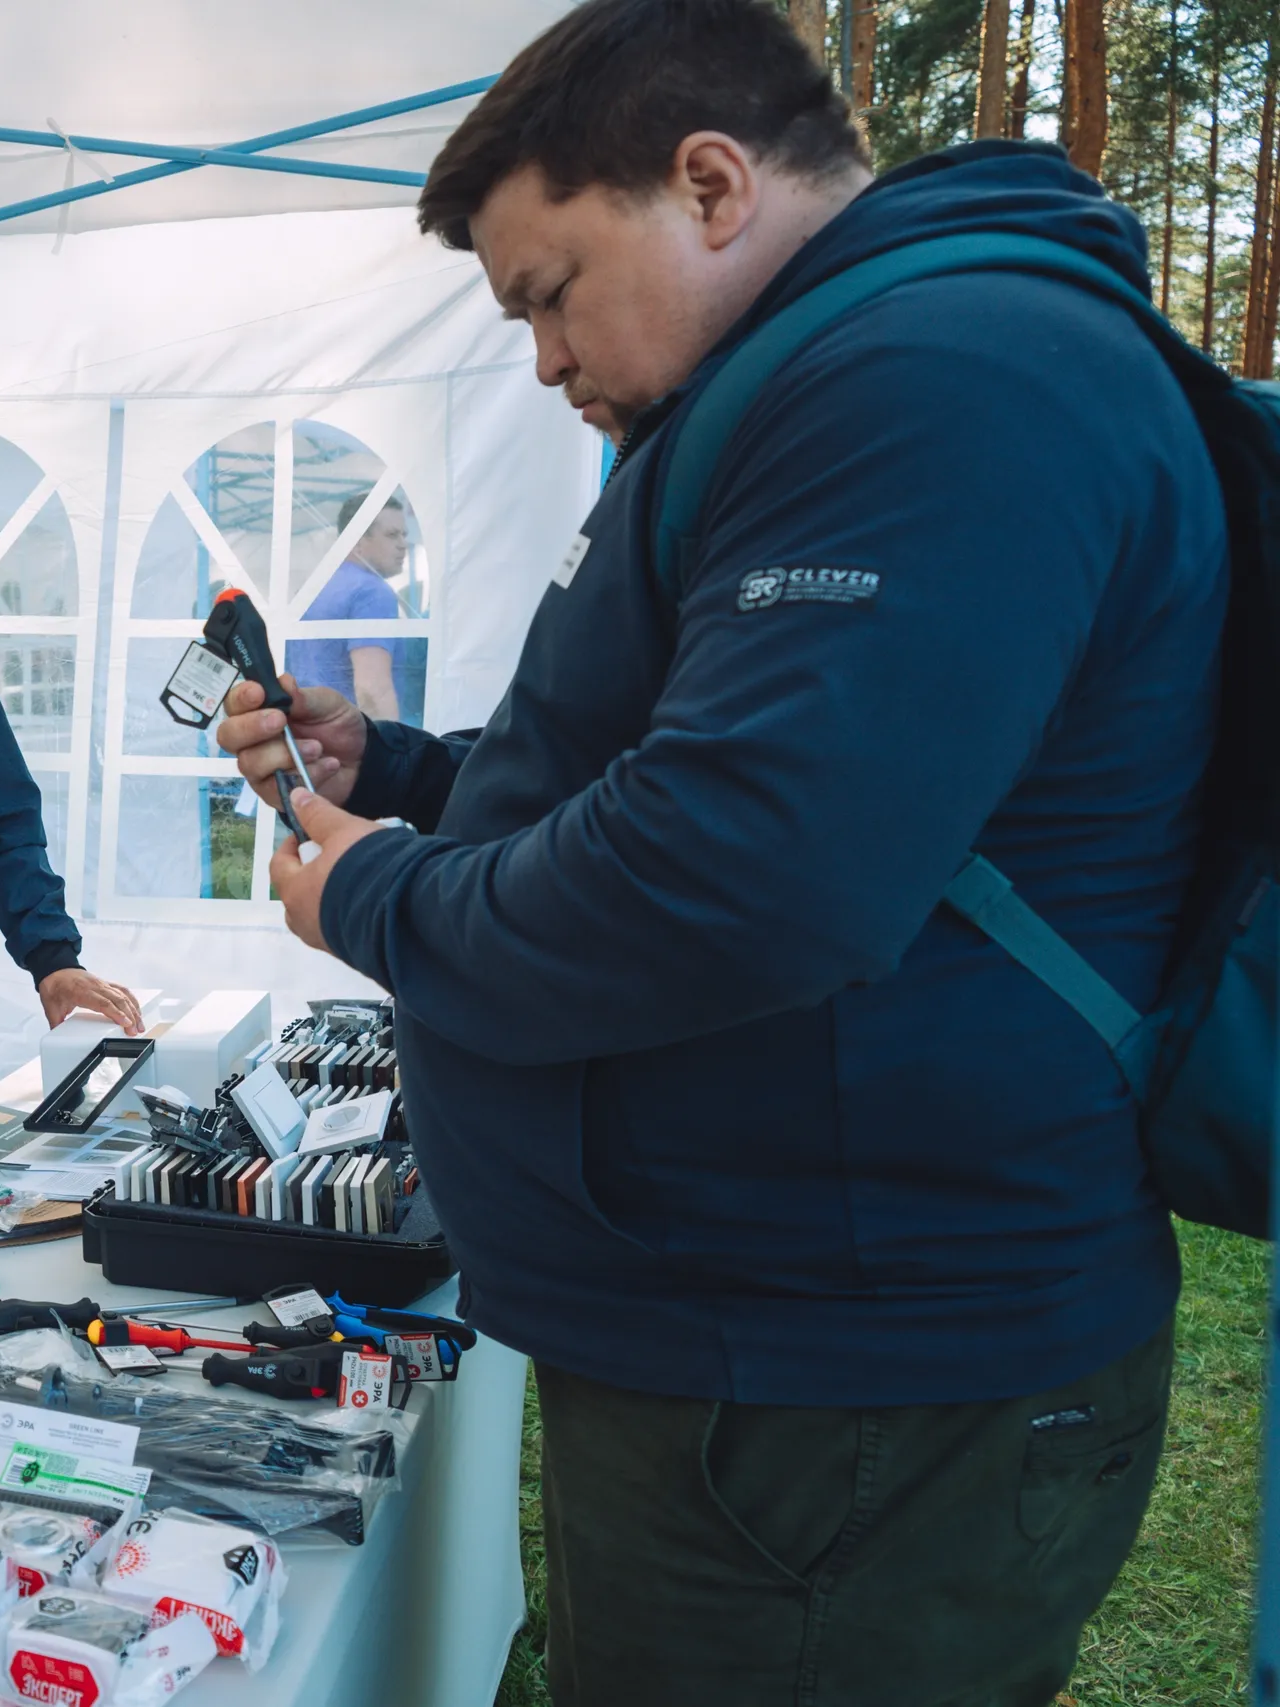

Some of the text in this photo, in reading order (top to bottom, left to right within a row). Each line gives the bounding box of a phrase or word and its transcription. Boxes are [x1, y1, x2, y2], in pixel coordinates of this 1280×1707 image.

[788, 568, 880, 585] CLEVER
[233, 635, 253, 667] 100PH2
[248, 1366, 262, 1375] ЭРА
[422, 1355, 433, 1373] ЭРА
[372, 1382, 383, 1403] ЭРА
[17, 1419, 35, 1431] ЭРА
